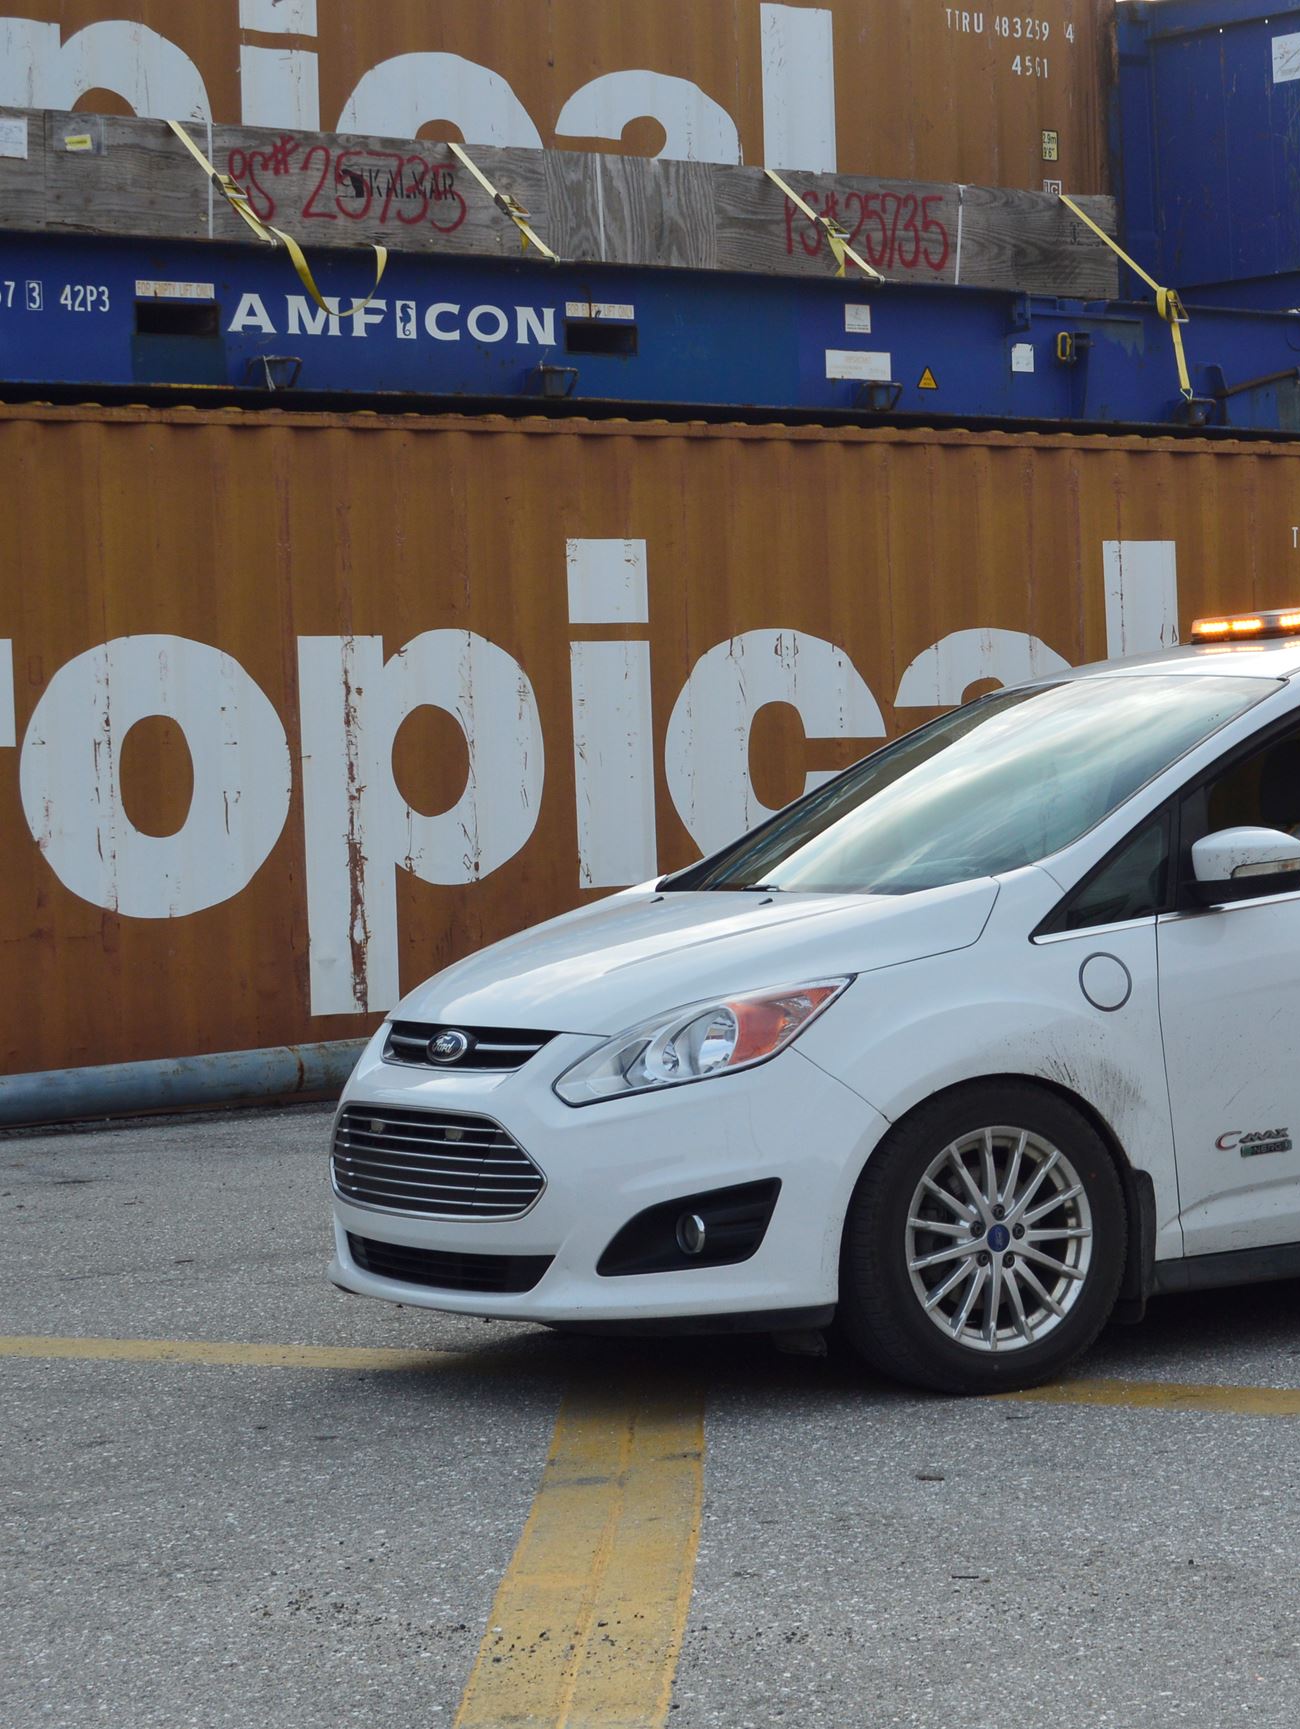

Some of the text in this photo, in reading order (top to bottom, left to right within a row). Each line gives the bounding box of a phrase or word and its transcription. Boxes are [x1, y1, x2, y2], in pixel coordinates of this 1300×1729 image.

[946, 8, 984, 33] TTRU
[994, 16, 1050, 41] 483259
[28, 282, 42, 309] 3
[60, 284, 110, 312] 42P3
[431, 1034, 456, 1054] Ford
